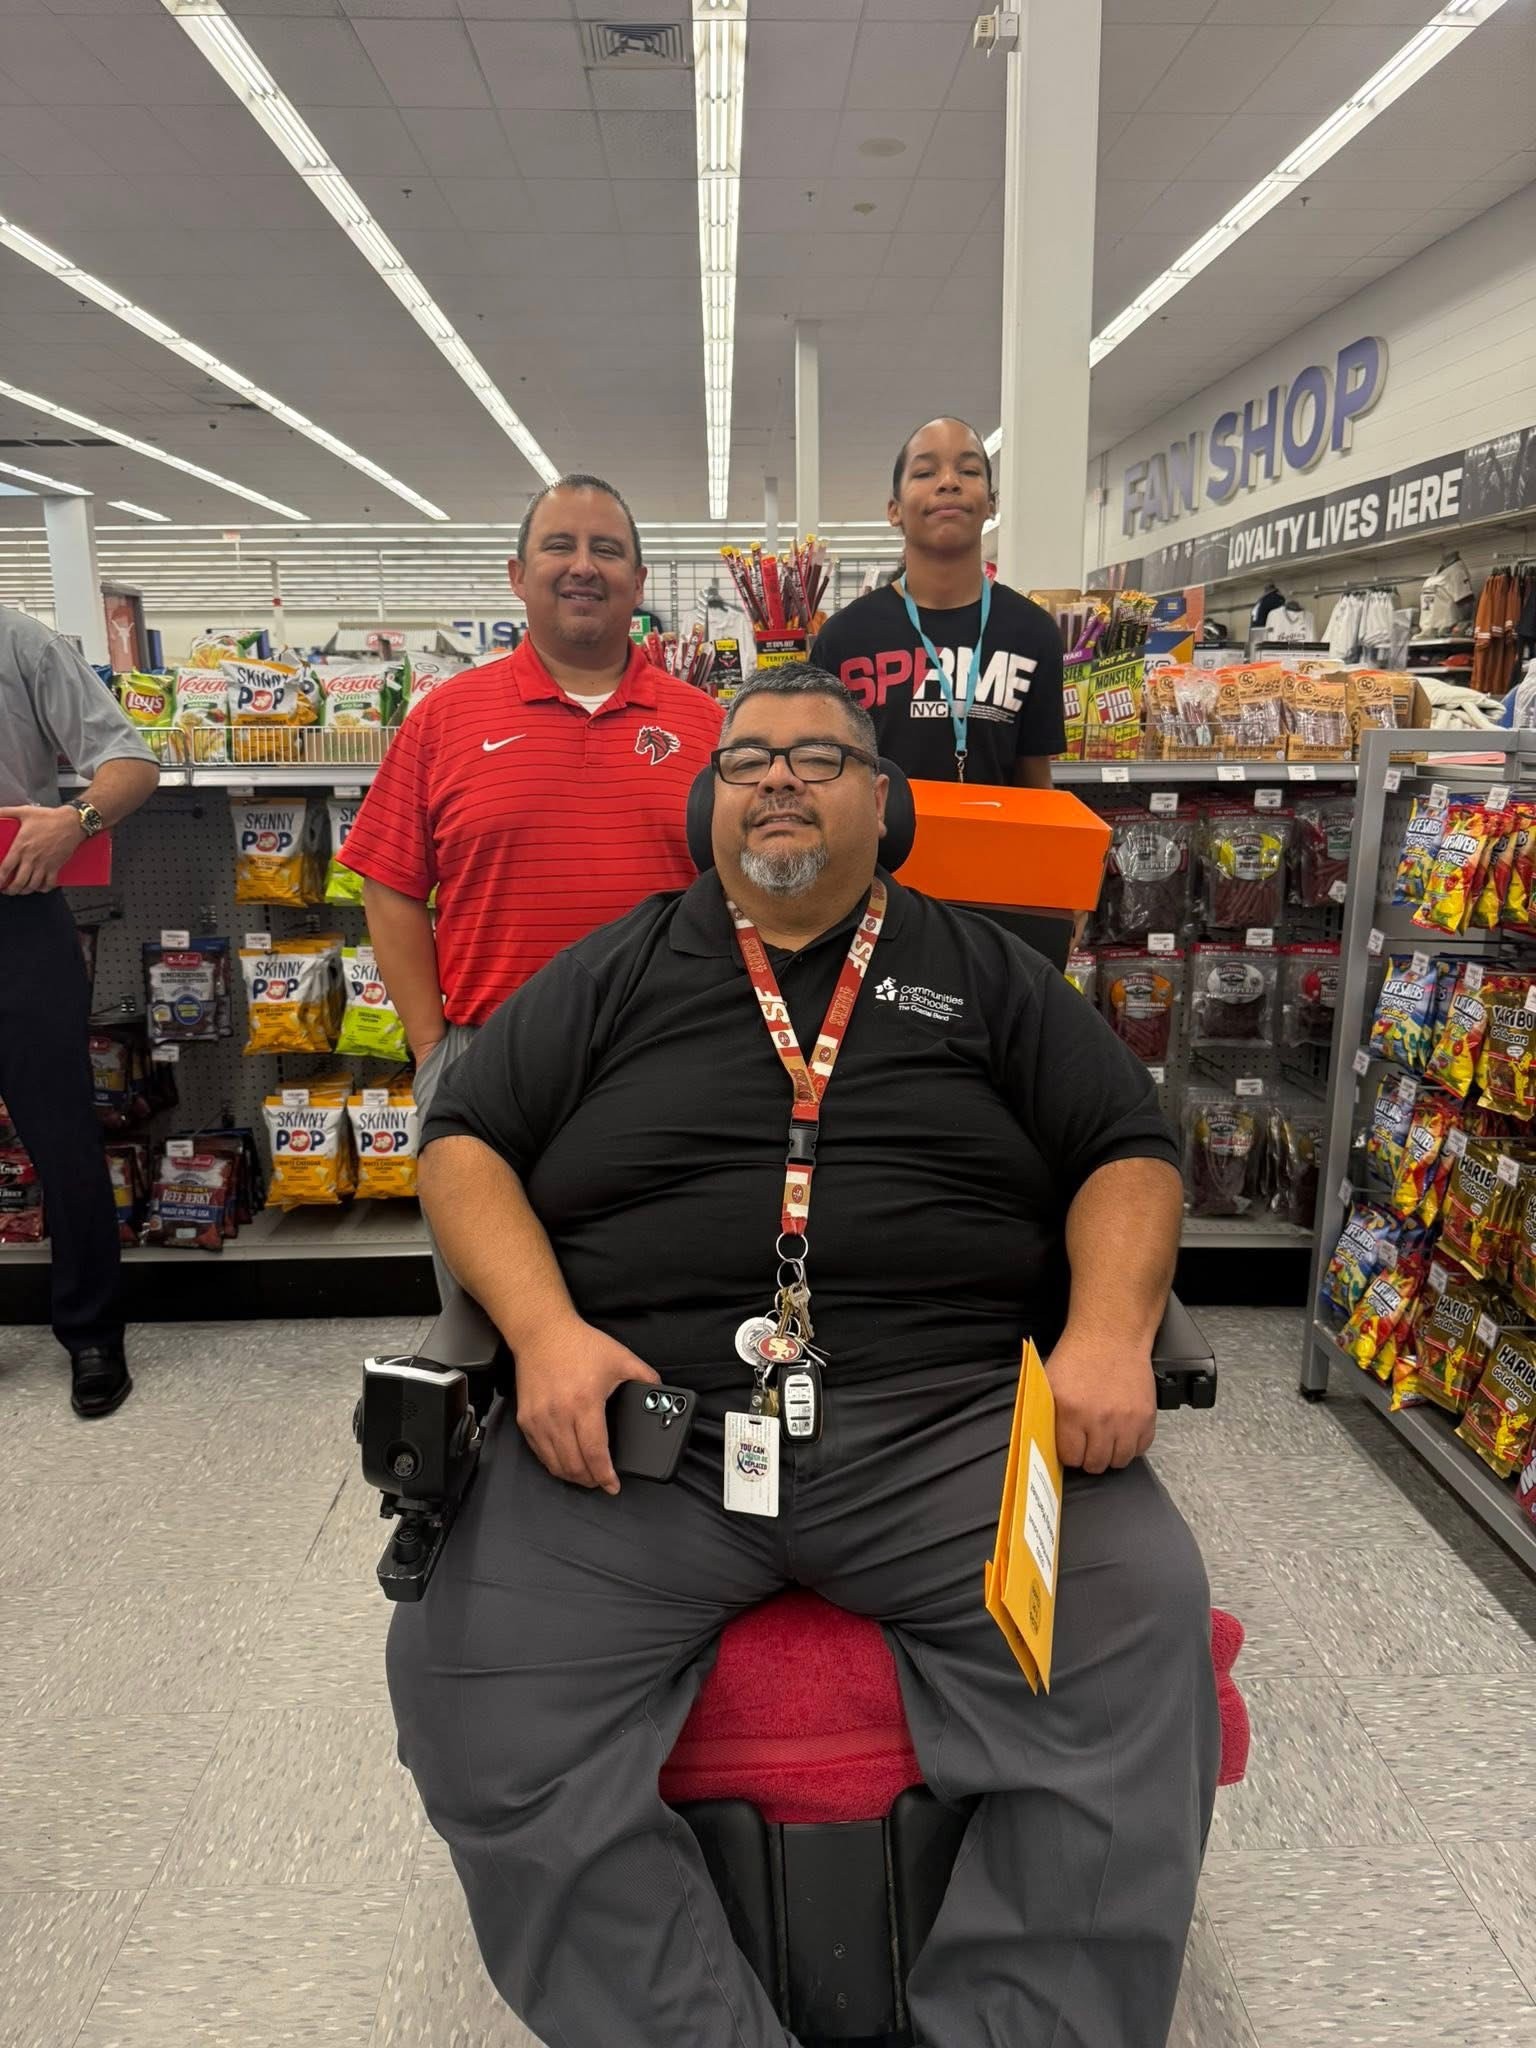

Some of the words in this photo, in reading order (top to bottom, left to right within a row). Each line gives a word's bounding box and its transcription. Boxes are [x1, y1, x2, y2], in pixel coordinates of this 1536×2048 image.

[1122, 431, 1202, 536] FAN
[1206, 336, 1388, 506] SHOP
[1228, 513, 1305, 569] LOYALTY
[1306, 493, 1379, 551] LIVES
[1386, 467, 1463, 532] HERE
[1099, 658, 1114, 667] HOT
[321, 675, 384, 695] Veggie
[1095, 666, 1136, 691] MONSTER
[238, 686, 284, 713] POP
[1096, 686, 1132, 710] slim
[912, 703, 946, 717] NYC
[1106, 702, 1135, 724] jim
[242, 831, 293, 852] POP
[848, 933, 874, 978] SF
[253, 978, 300, 1000] POP
[900, 985, 964, 1006] Communities
[754, 986, 790, 1025] SF
[900, 994, 909, 1002] In
[911, 993, 949, 1011] Schools
[911, 1004, 933, 1018] Coastal
[933, 1012, 949, 1022] Bend
[276, 1129, 326, 1152] POP
[361, 1131, 409, 1153] POP
[162, 1189, 182, 1203] BEEF
[183, 1190, 213, 1205] JERKY
[162, 1207, 177, 1215] MADE
[186, 1208, 197, 1216] THE
[198, 1208, 210, 1217] USA
[1435, 1294, 1475, 1325] HARIBO
[1492, 1366, 1532, 1408] Goldbears
[741, 1442, 752, 1453] YOU
[753, 1445, 765, 1455] CAN
[745, 1460, 768, 1471] REPLACED
